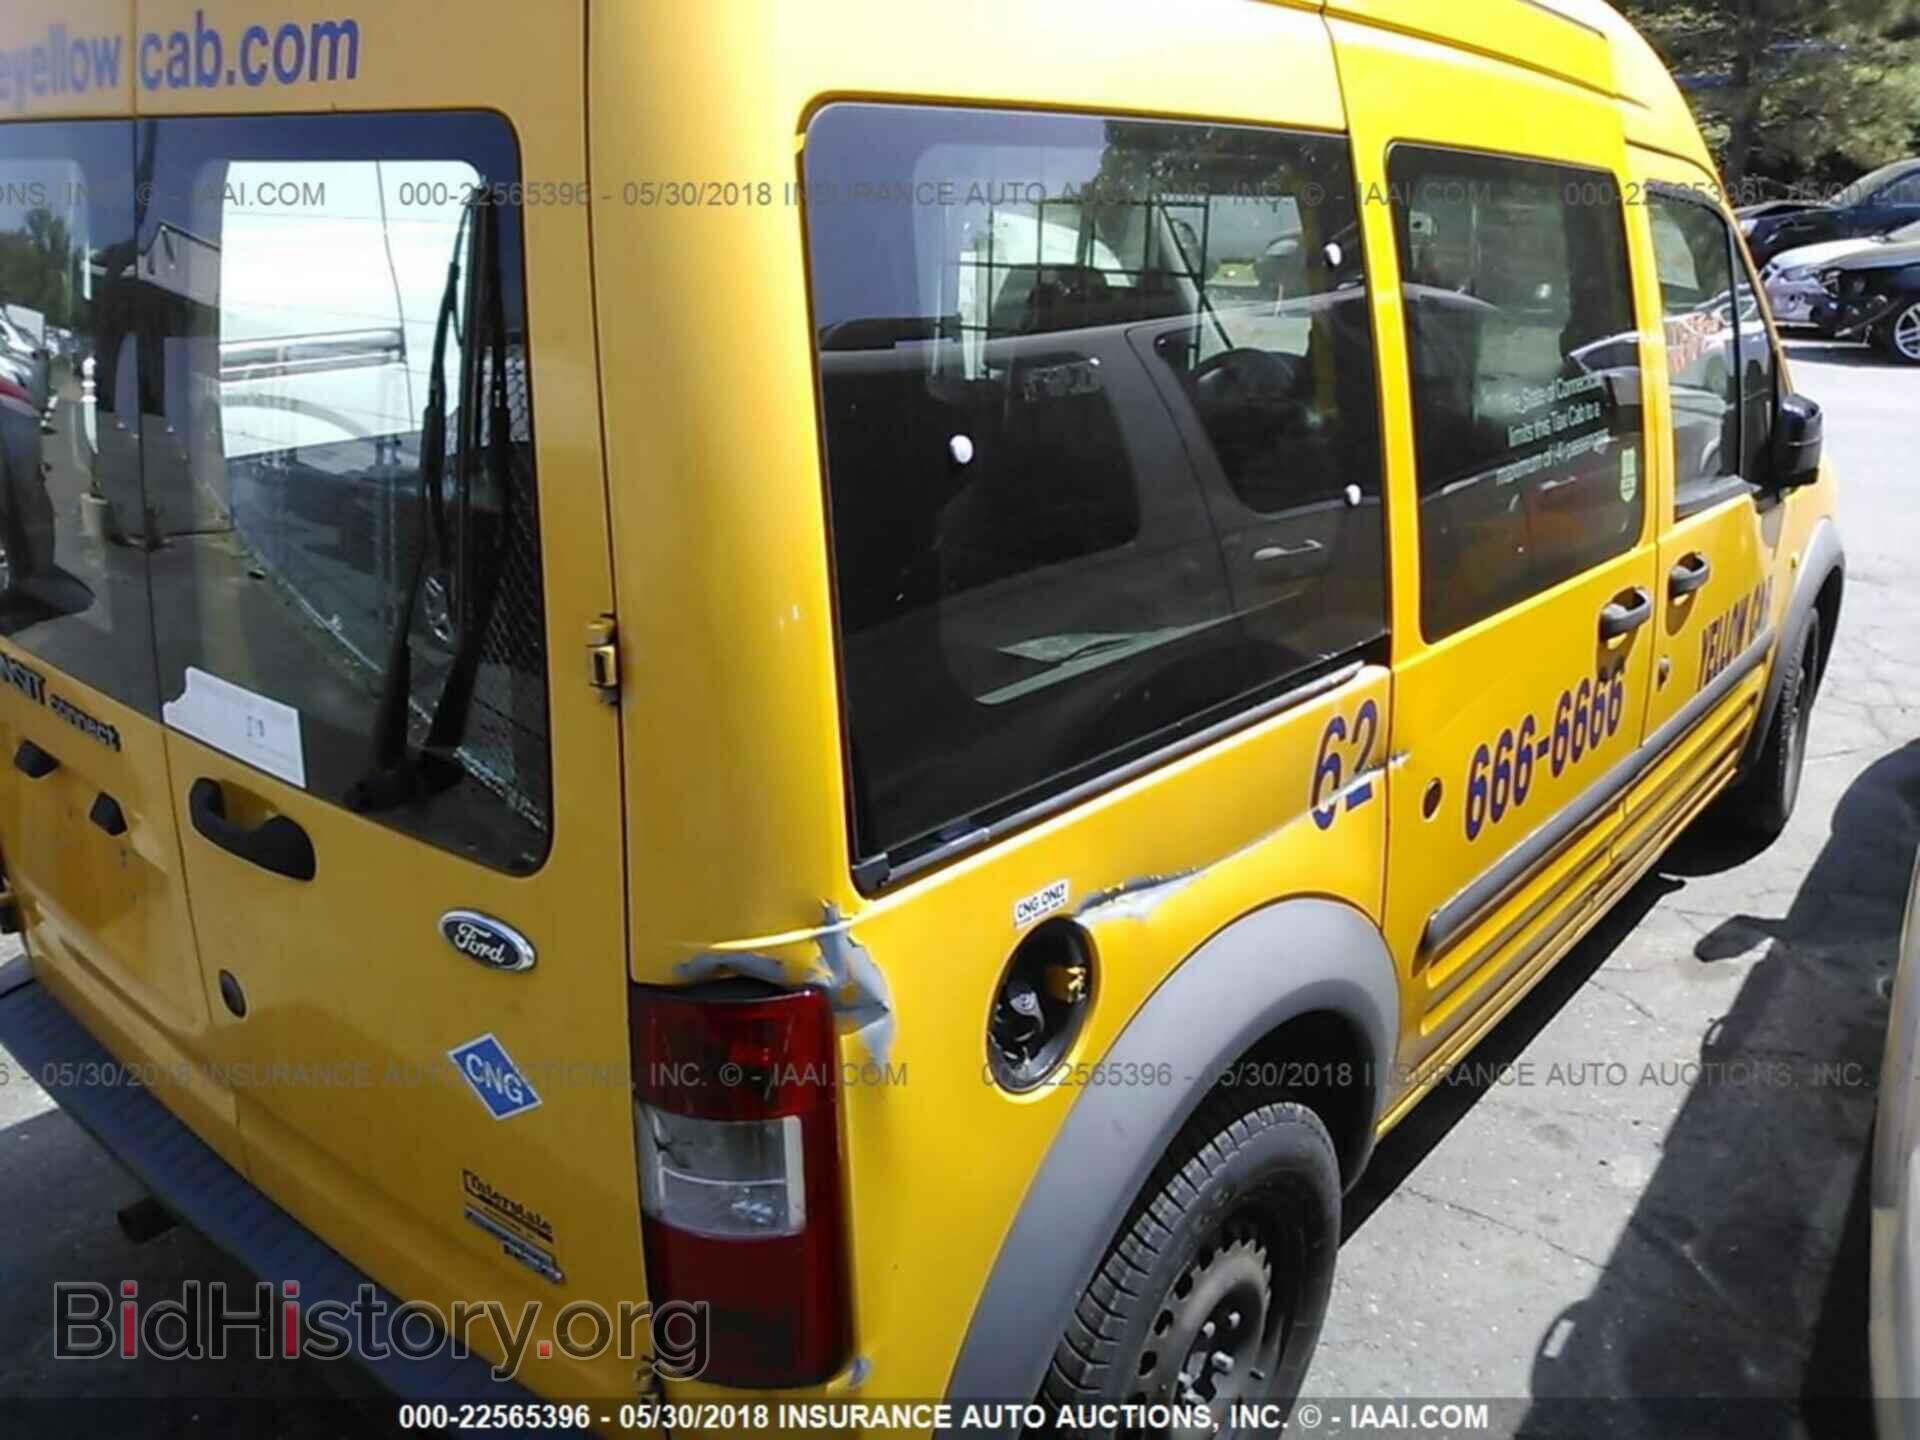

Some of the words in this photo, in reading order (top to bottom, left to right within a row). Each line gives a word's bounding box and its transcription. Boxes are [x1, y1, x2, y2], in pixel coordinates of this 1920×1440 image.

[138, 10, 360, 91] cab.com
[1310, 698, 1378, 831] 62
[1464, 670, 1623, 842] 666-6666
[454, 922, 506, 963] Ford
[465, 1053, 524, 1106] CNG
